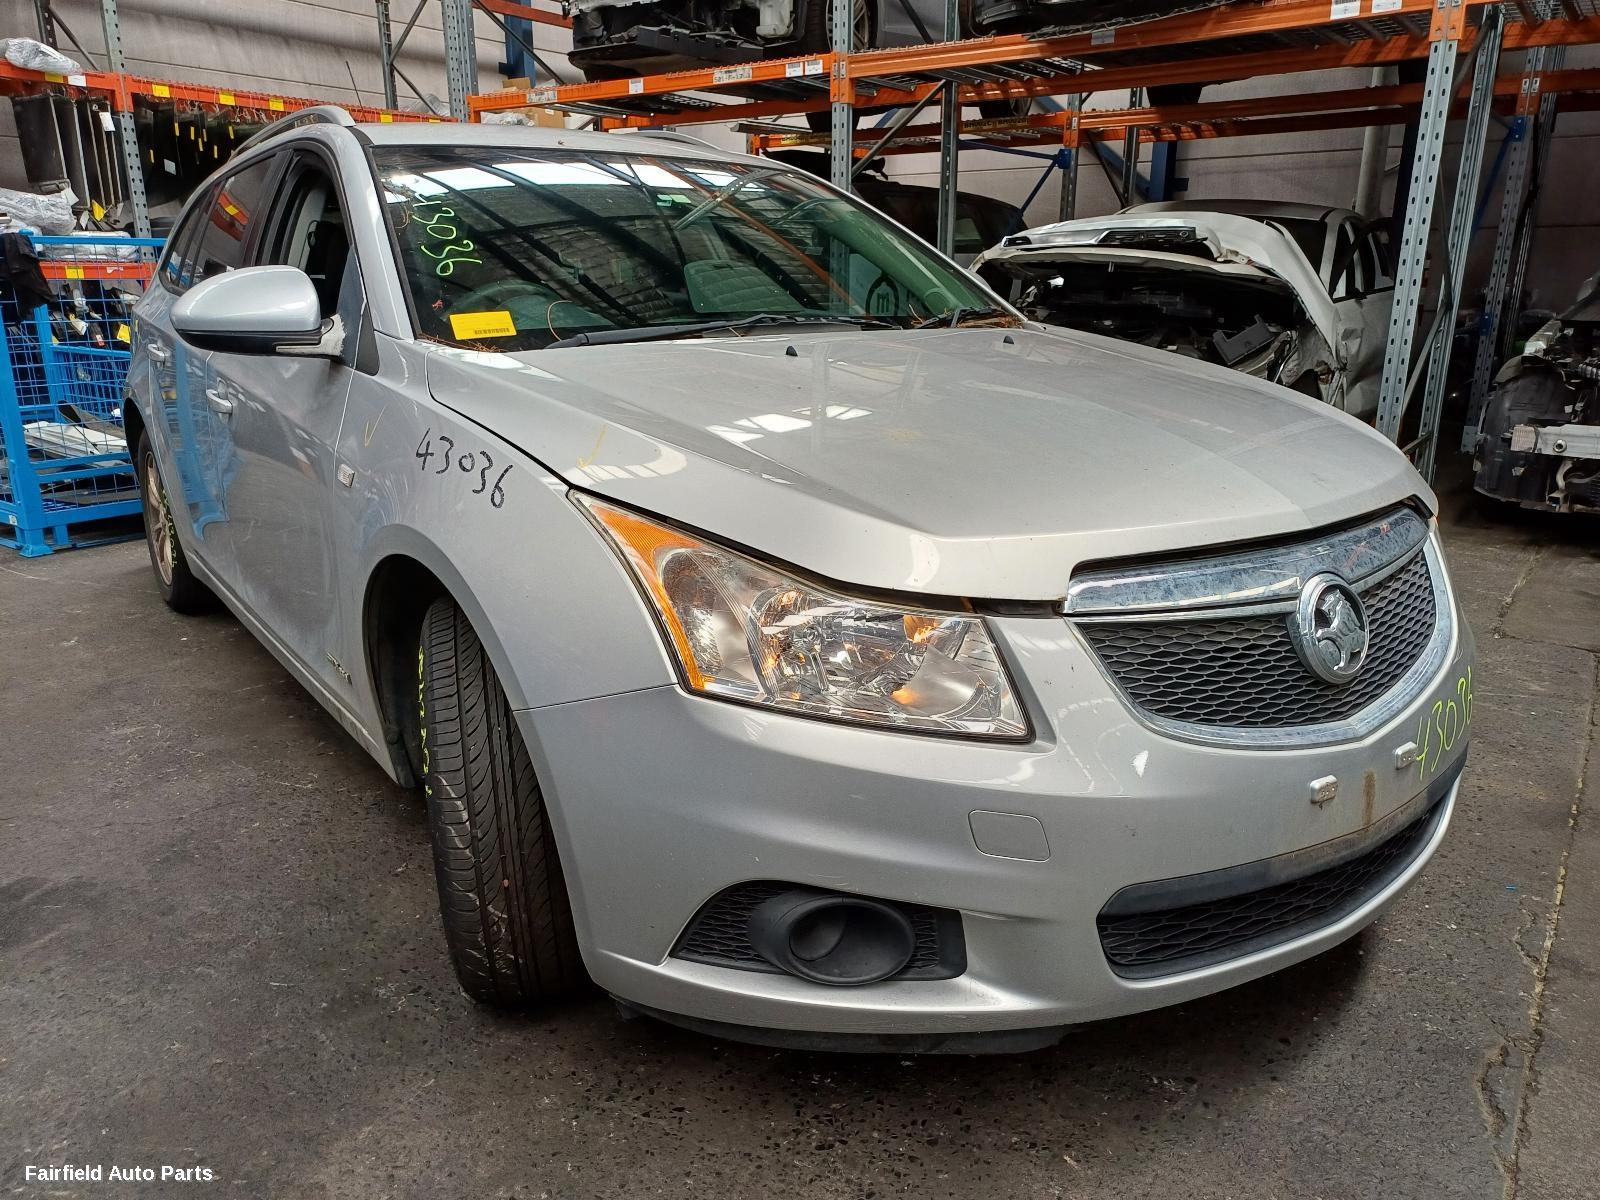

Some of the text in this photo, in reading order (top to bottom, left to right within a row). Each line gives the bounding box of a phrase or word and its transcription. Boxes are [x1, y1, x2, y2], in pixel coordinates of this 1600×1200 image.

[412, 192, 483, 276] 43036
[415, 427, 514, 509] 43036
[1415, 664, 1473, 781] 43036
